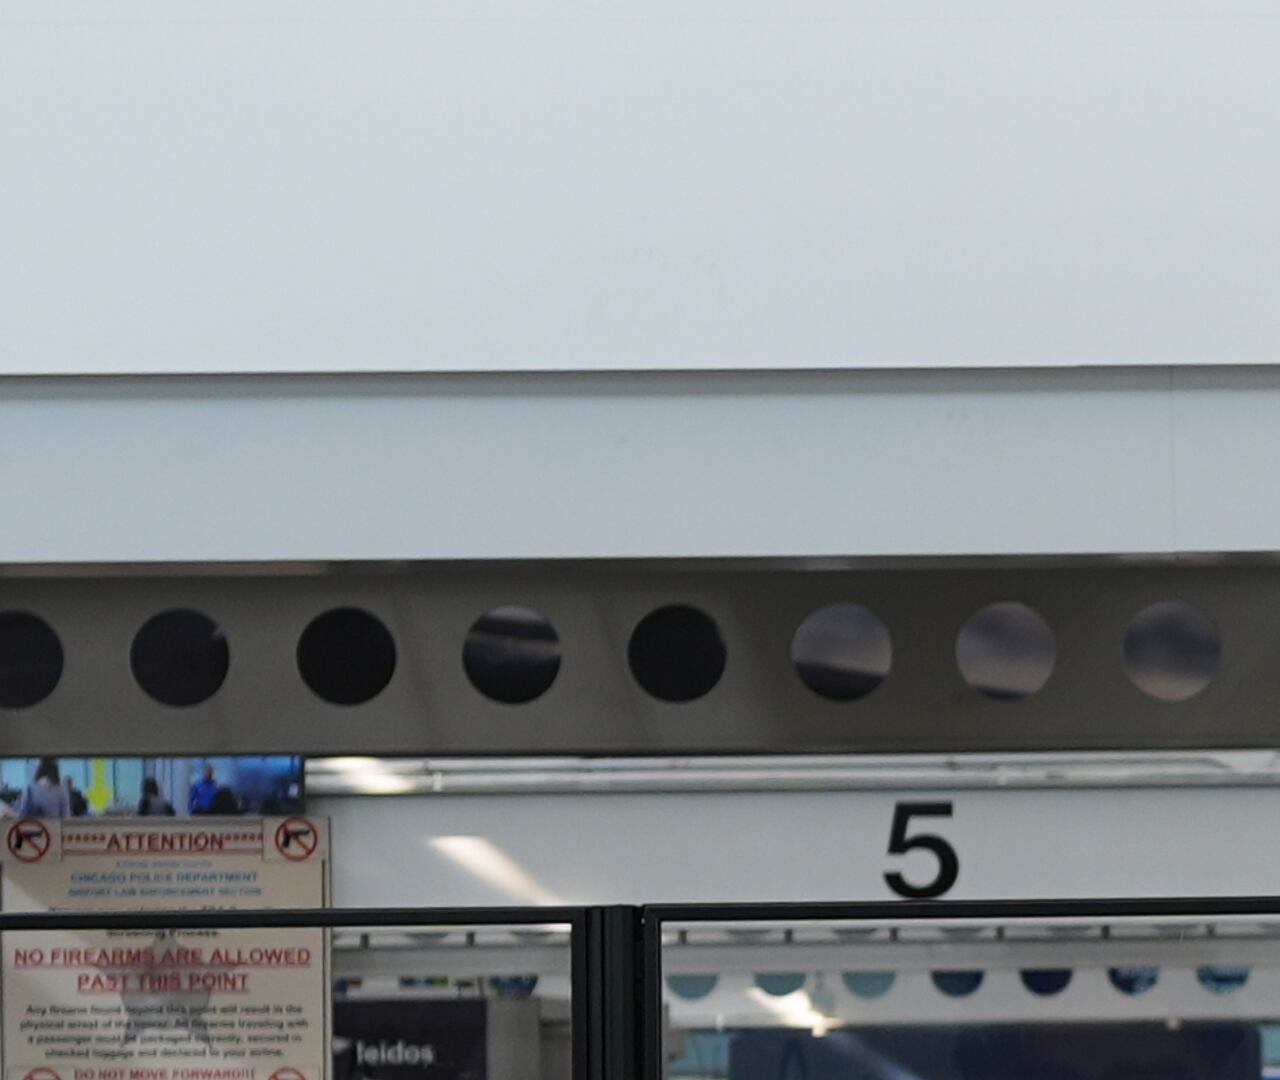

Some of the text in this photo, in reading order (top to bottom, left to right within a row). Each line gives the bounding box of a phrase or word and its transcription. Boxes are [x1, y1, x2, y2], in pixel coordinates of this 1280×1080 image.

[883, 801, 960, 899] 5
[14, 947, 311, 967] NO FIREARMS ARE ALLOWED
[77, 972, 250, 991] PAST THIS POINT
[355, 1039, 434, 1067] leidos
[74, 1068, 95, 1080] DO
[97, 1068, 126, 1080] NOT
[129, 1068, 170, 1080] MOVE
